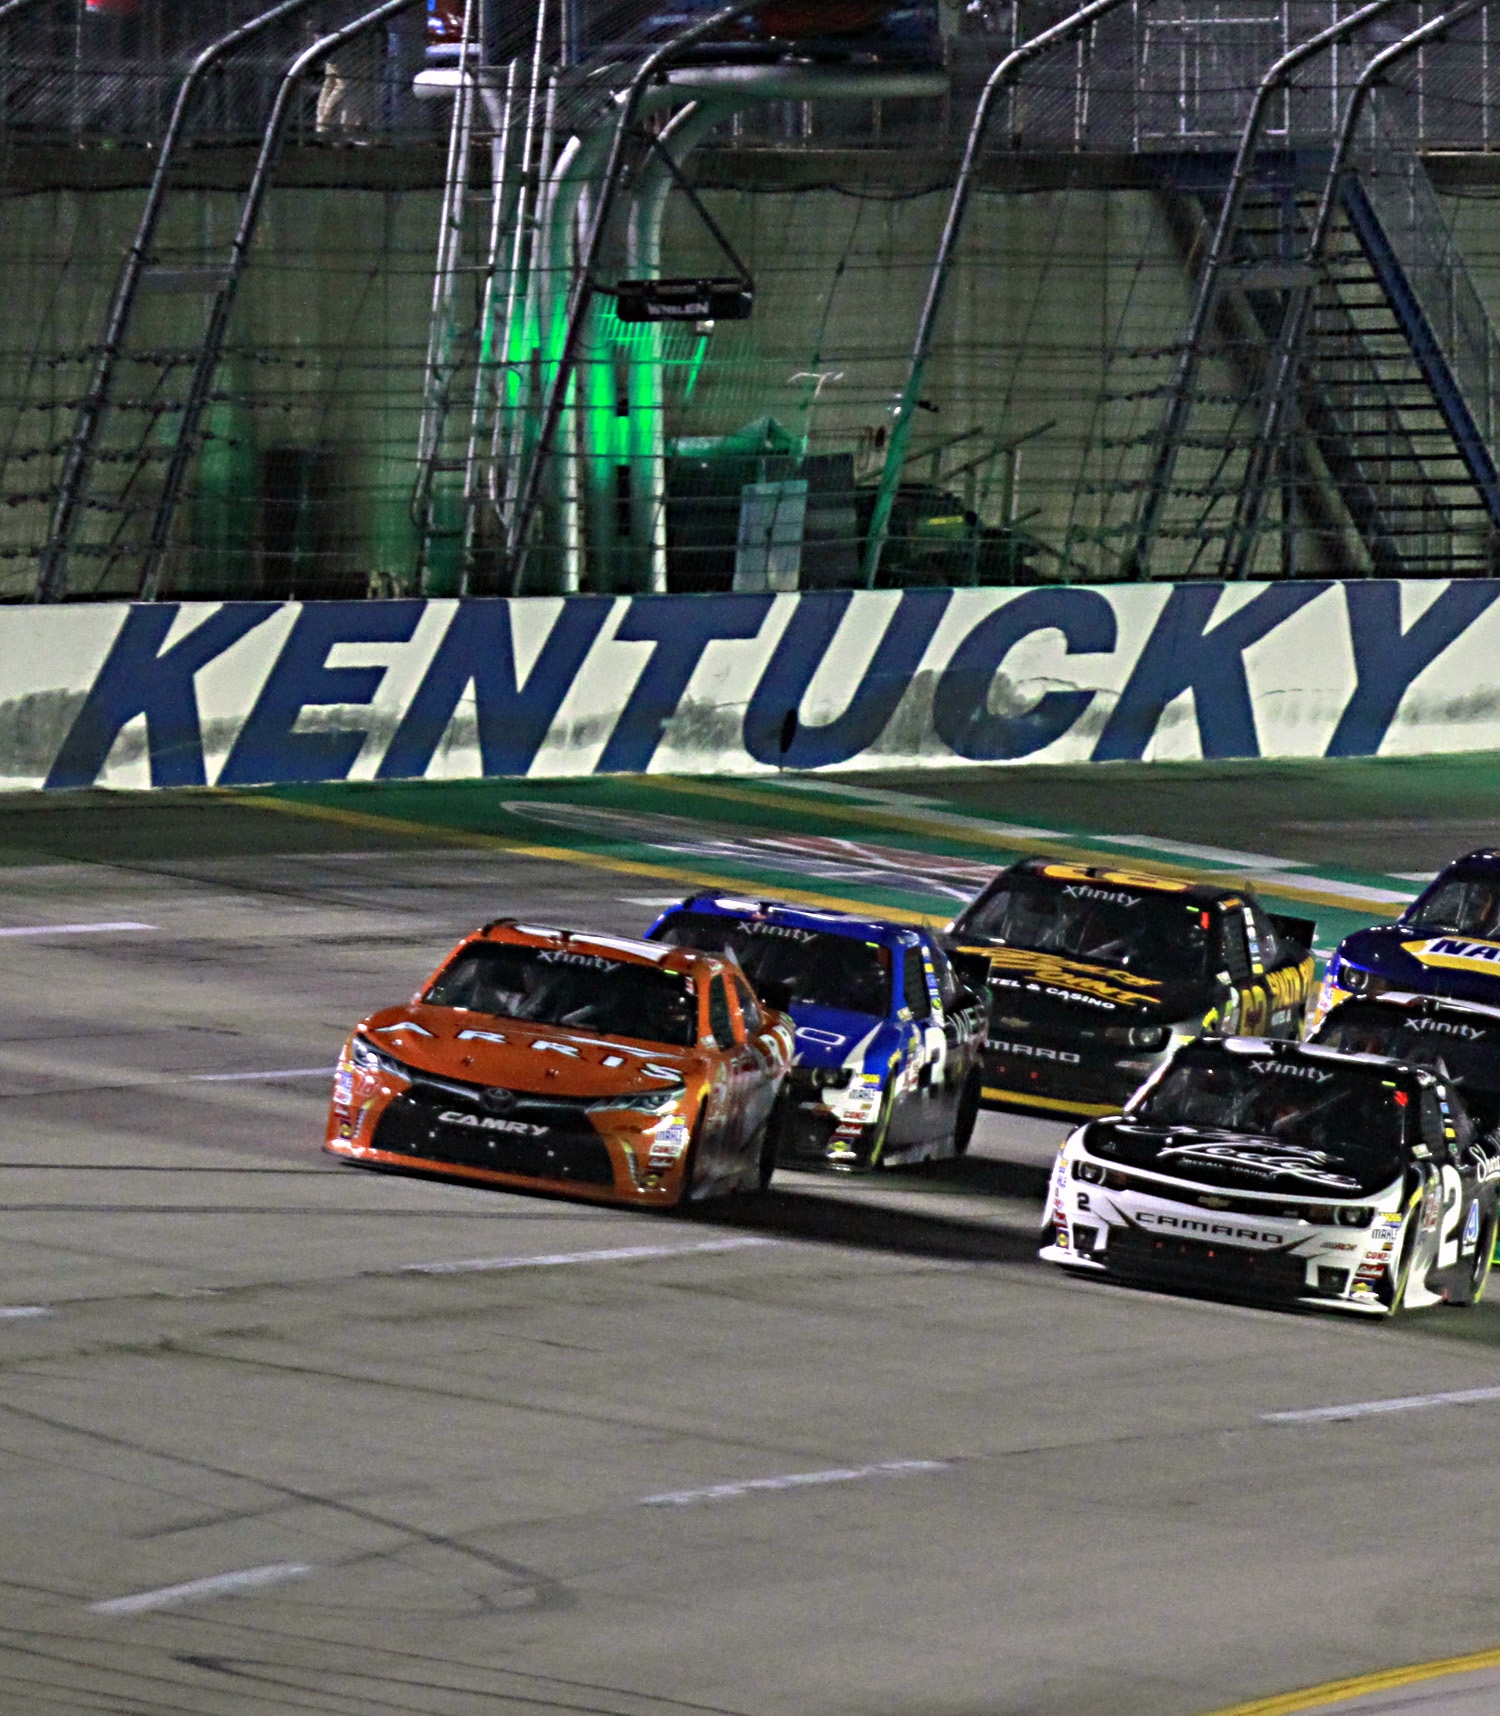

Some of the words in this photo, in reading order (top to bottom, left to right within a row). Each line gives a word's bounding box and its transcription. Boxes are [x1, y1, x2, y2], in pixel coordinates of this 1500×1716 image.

[1062, 884, 1143, 907] xfinity
[737, 921, 819, 943] xfinity
[538, 949, 621, 971] xfinity
[1046, 986, 1116, 1009] CASINO
[1404, 1017, 1487, 1039] xfinity
[375, 1021, 684, 1082] ARRIS
[984, 1039, 1081, 1064] MARO
[1249, 1060, 1334, 1082] xfinity
[438, 1110, 549, 1137] CAMRY
[1077, 1192, 1092, 1213] 2
[1136, 1211, 1284, 1244] CAMARO
[1438, 1164, 1463, 1268] 2
